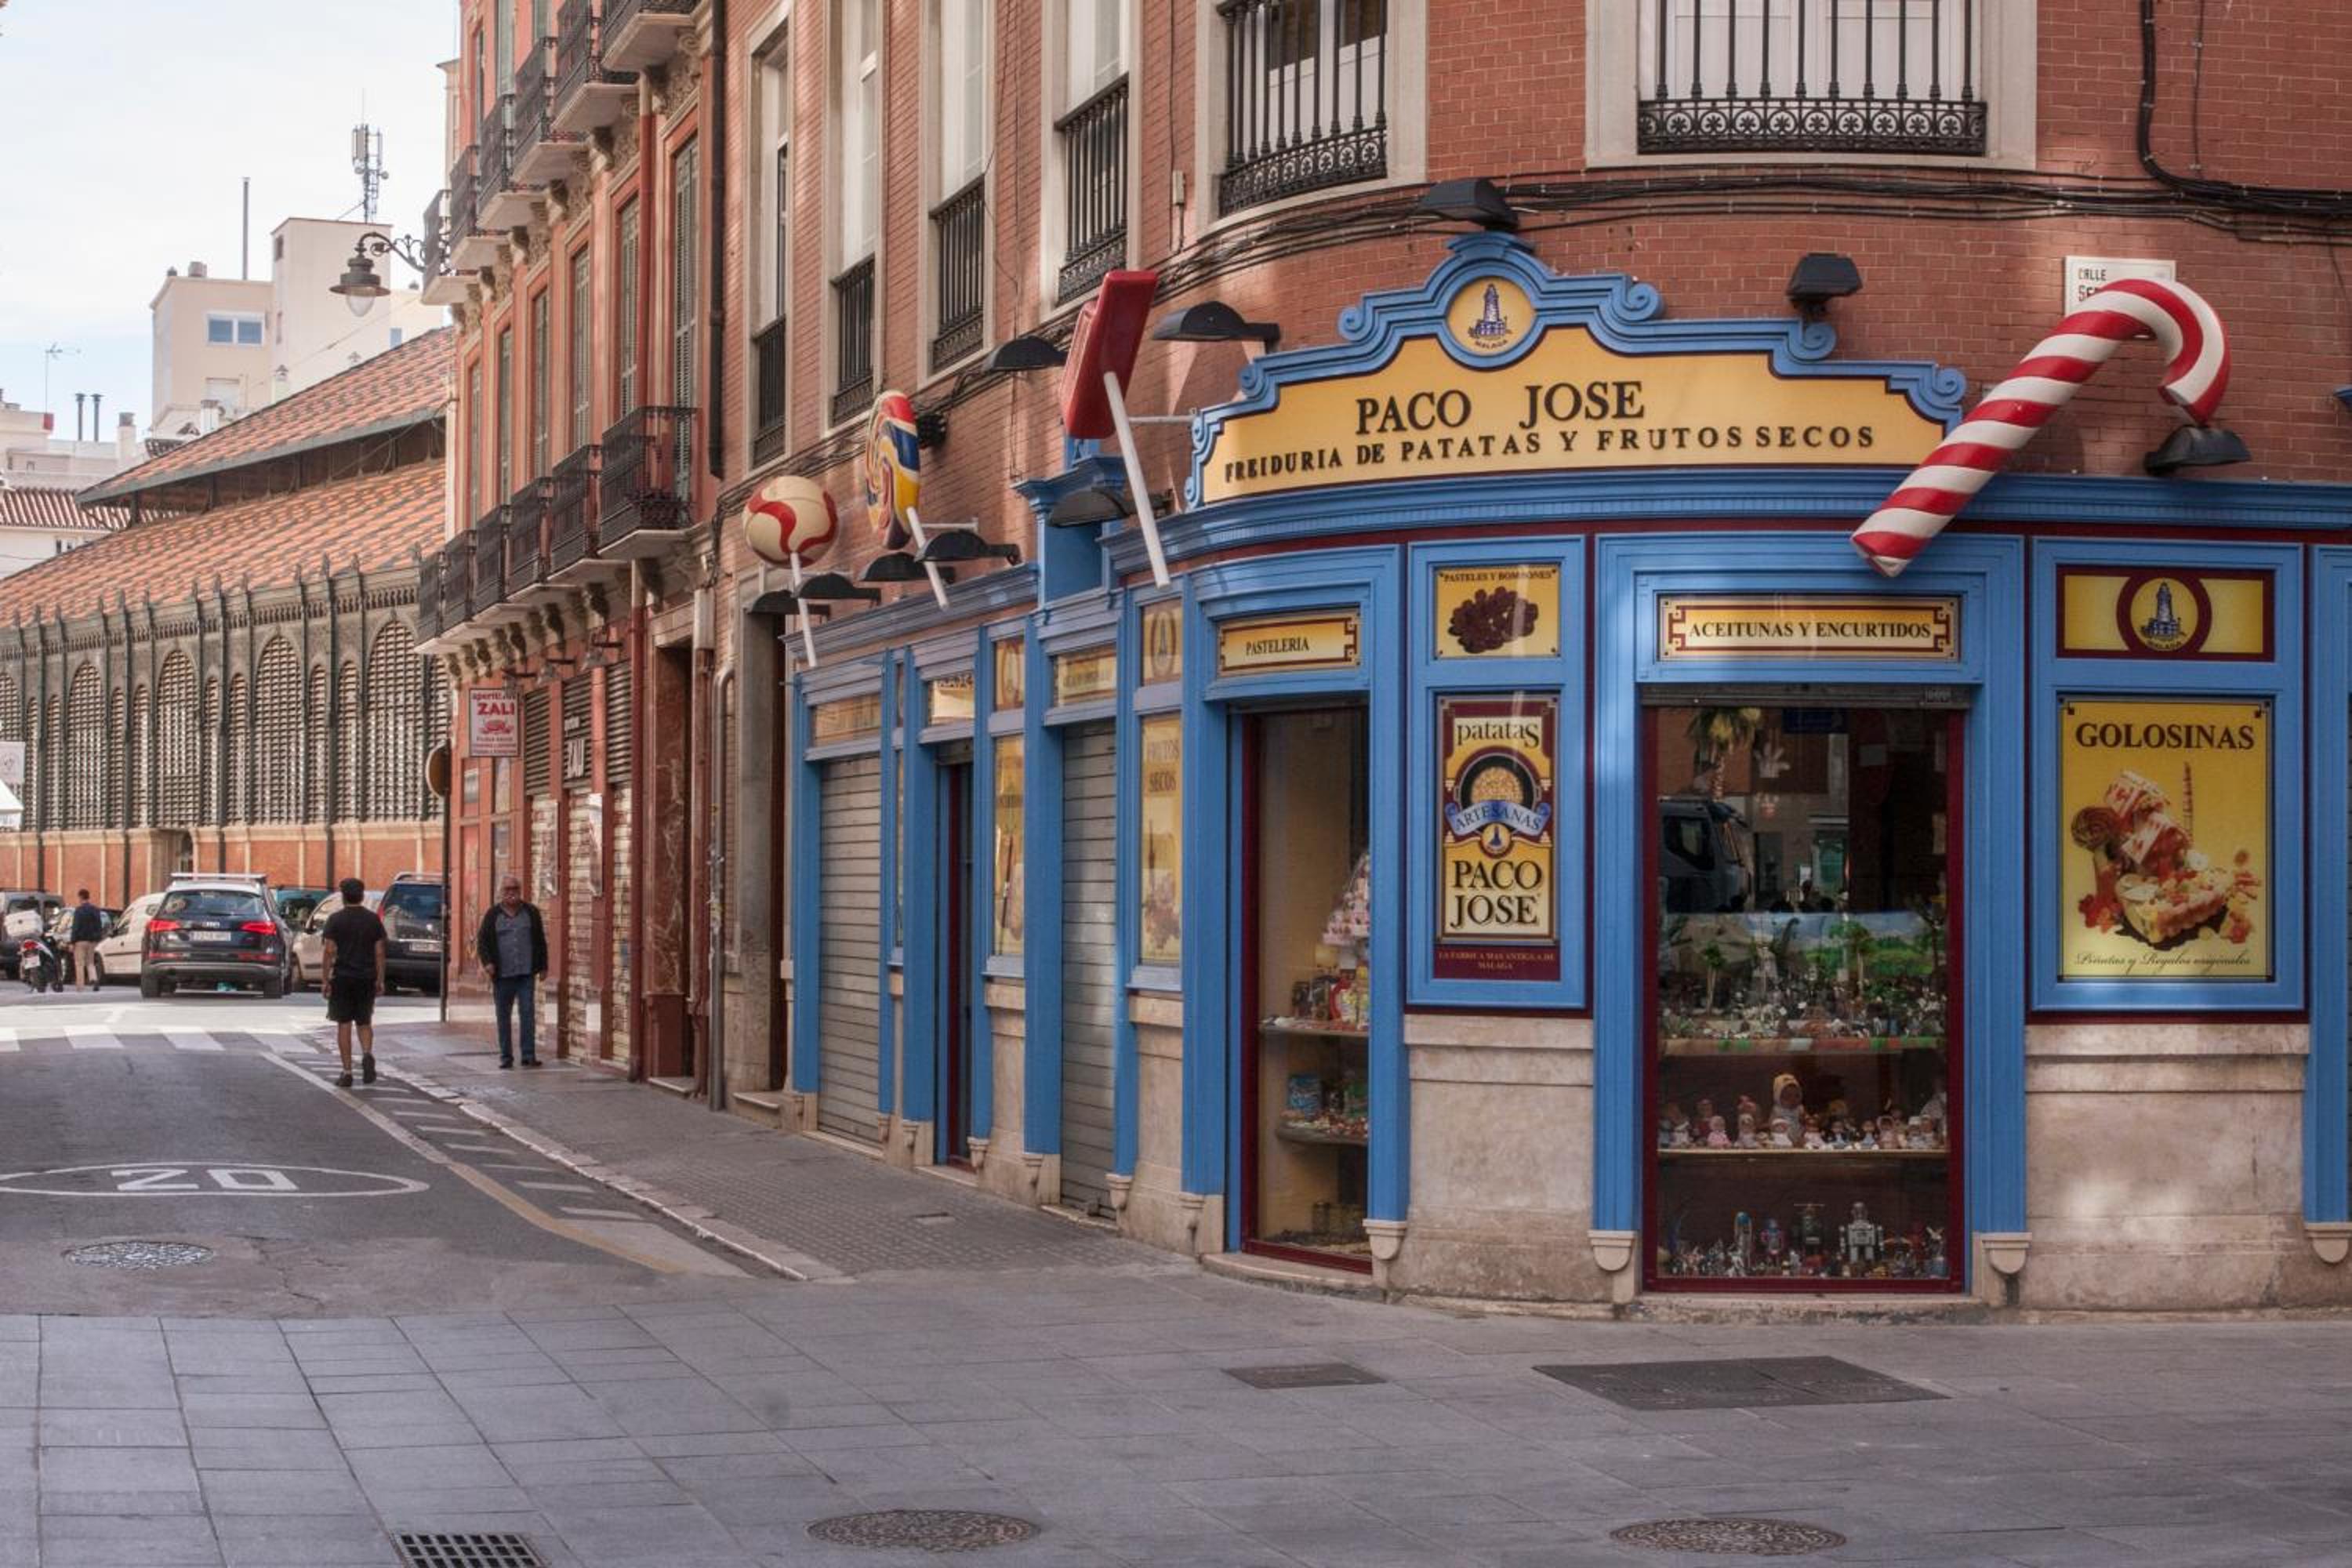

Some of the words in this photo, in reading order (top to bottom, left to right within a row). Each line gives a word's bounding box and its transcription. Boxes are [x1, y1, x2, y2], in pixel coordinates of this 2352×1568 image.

[2078, 267, 2107, 281] CALLE
[1356, 390, 1472, 435] PACO
[1519, 381, 1645, 430] JOSE
[1225, 448, 1343, 483] FREIDURIA
[1356, 443, 1385, 466] DE
[1401, 432, 1541, 462] PATATAS
[1559, 430, 1578, 452] Y
[1596, 426, 1742, 452] FRUTOS
[1755, 426, 1874, 448] SECOS
[1498, 570, 1552, 581] BOMONES
[1690, 621, 1794, 638] ACEITUNAS
[1798, 622, 1812, 638] Y
[1816, 622, 1931, 638] ENCURTIDOS
[1245, 636, 1309, 656] PASTELERIA
[477, 702, 515, 715] ZALI
[2075, 722, 2255, 750] GOLOSINAS
[1456, 804, 1541, 830] ARTESANAS
[1452, 860, 1543, 890] PACO
[1450, 895, 1538, 928] JOSE
